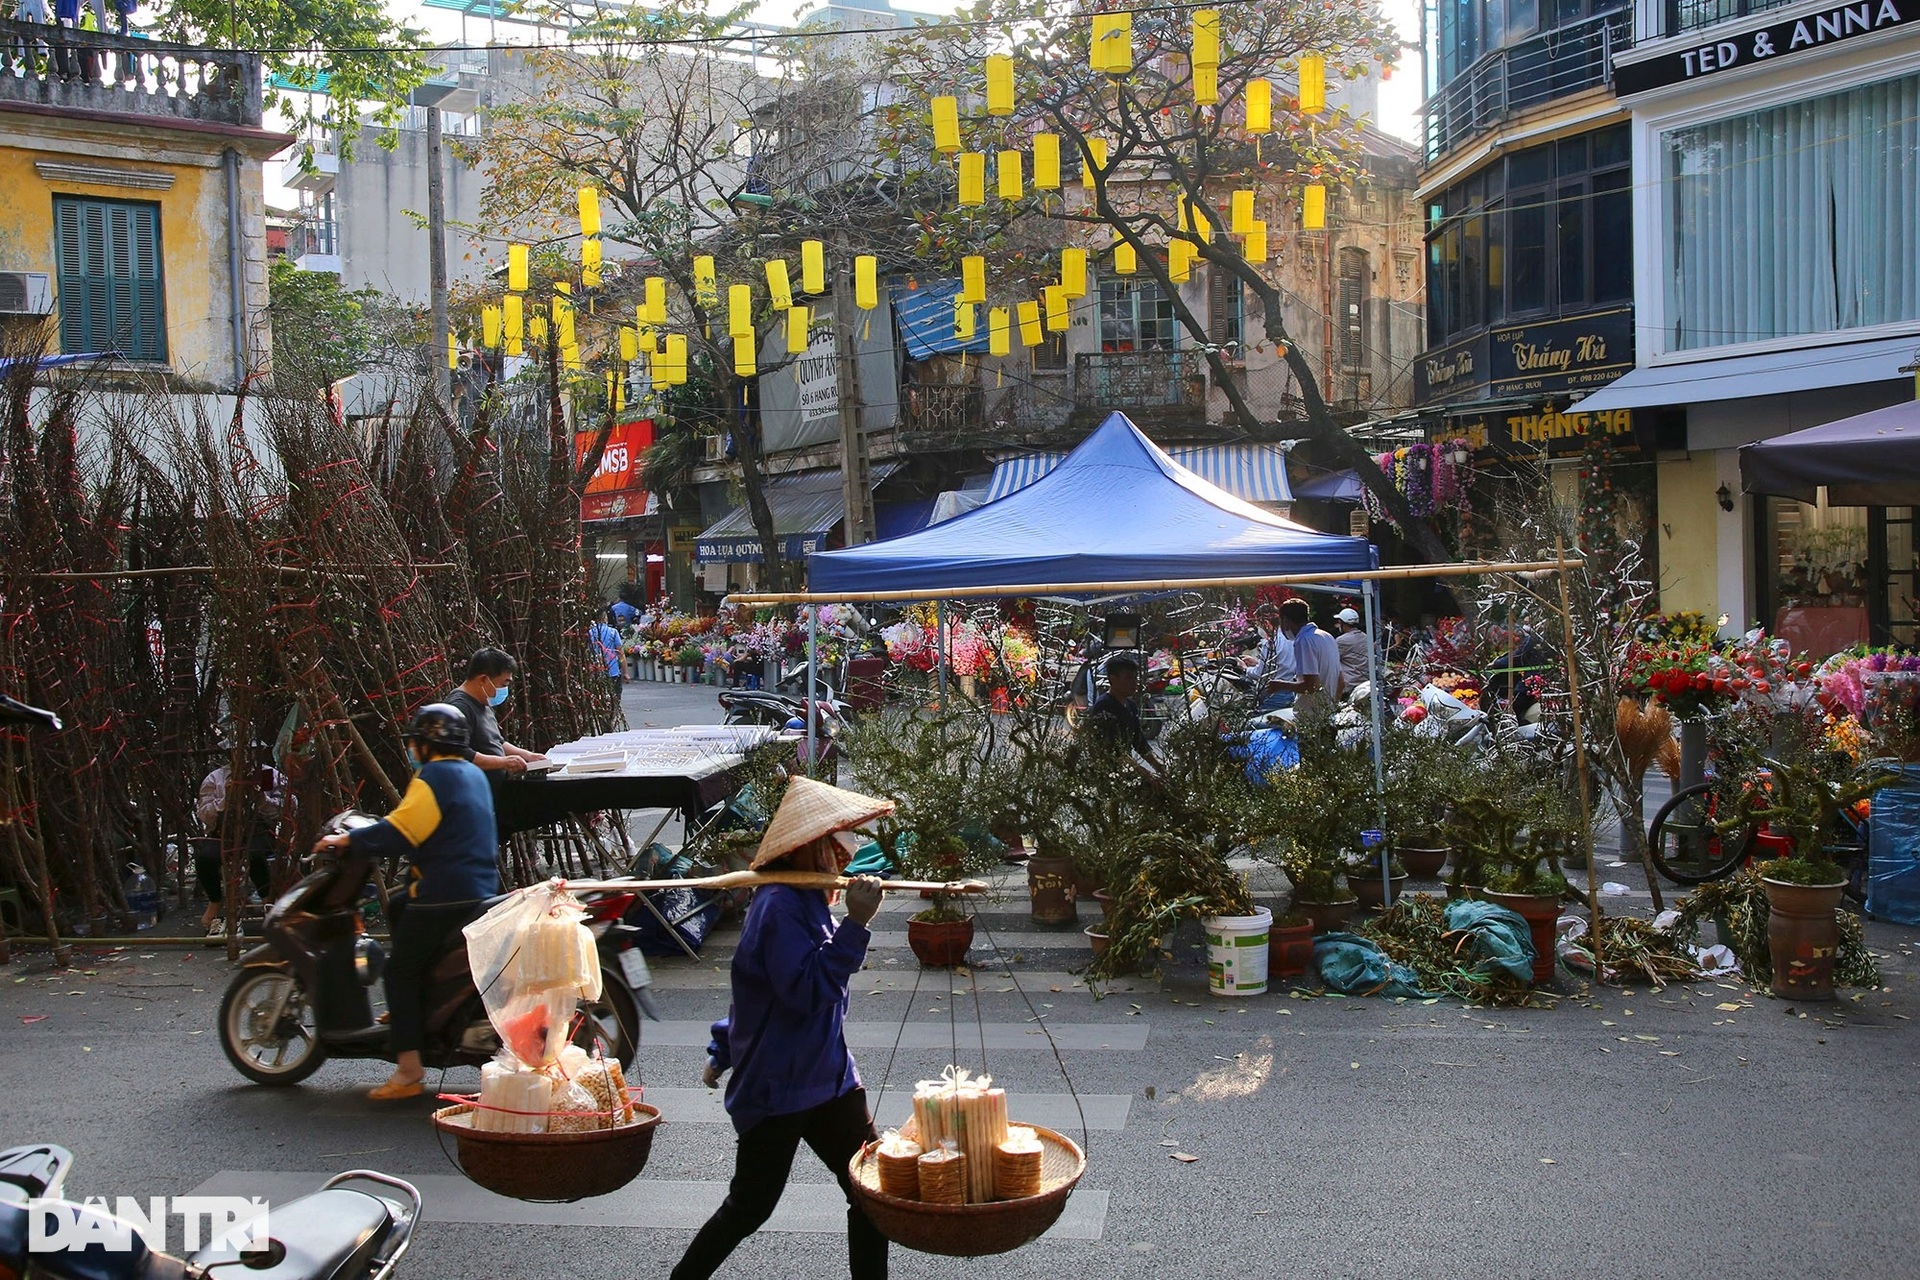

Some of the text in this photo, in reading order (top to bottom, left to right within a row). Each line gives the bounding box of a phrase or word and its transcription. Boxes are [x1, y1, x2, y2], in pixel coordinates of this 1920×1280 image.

[1680, 0, 1901, 76] TED & ANNA
[1497, 333, 1511, 343] HOA
[1512, 334, 1607, 371] Thắng Hà
[1507, 401, 1590, 443] THẮNG
[601, 447, 628, 474] MSB
[699, 545, 716, 556] HOA
[718, 545, 733, 559] LỤA
